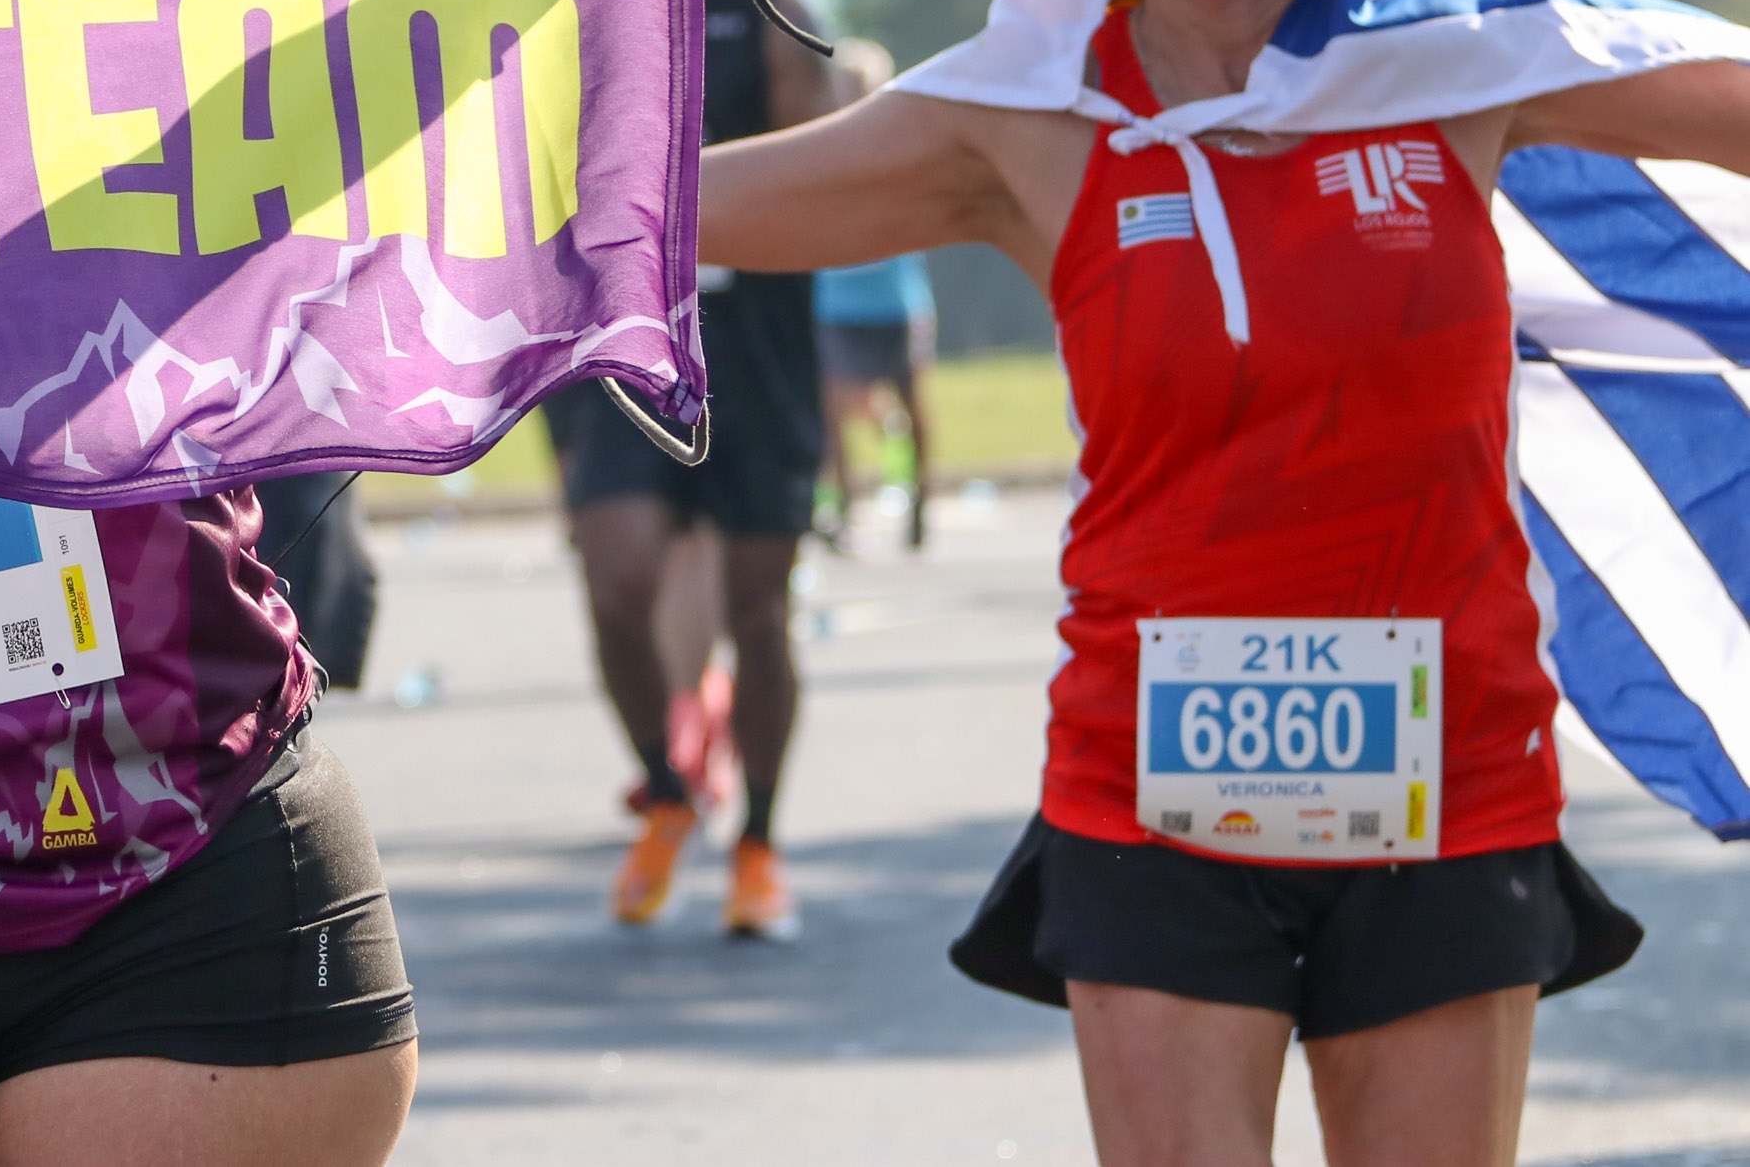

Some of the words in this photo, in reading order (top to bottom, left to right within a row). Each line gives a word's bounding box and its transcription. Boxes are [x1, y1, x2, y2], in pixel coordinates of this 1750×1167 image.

[58, 533, 70, 556] 1091
[77, 591, 90, 626] LOCKERS
[1241, 634, 1341, 672] 21K
[1179, 686, 1366, 771] 6860
[1217, 780, 1326, 798] VERONICA
[41, 830, 99, 851] GAMBA
[317, 925, 331, 987] DOMYOS
